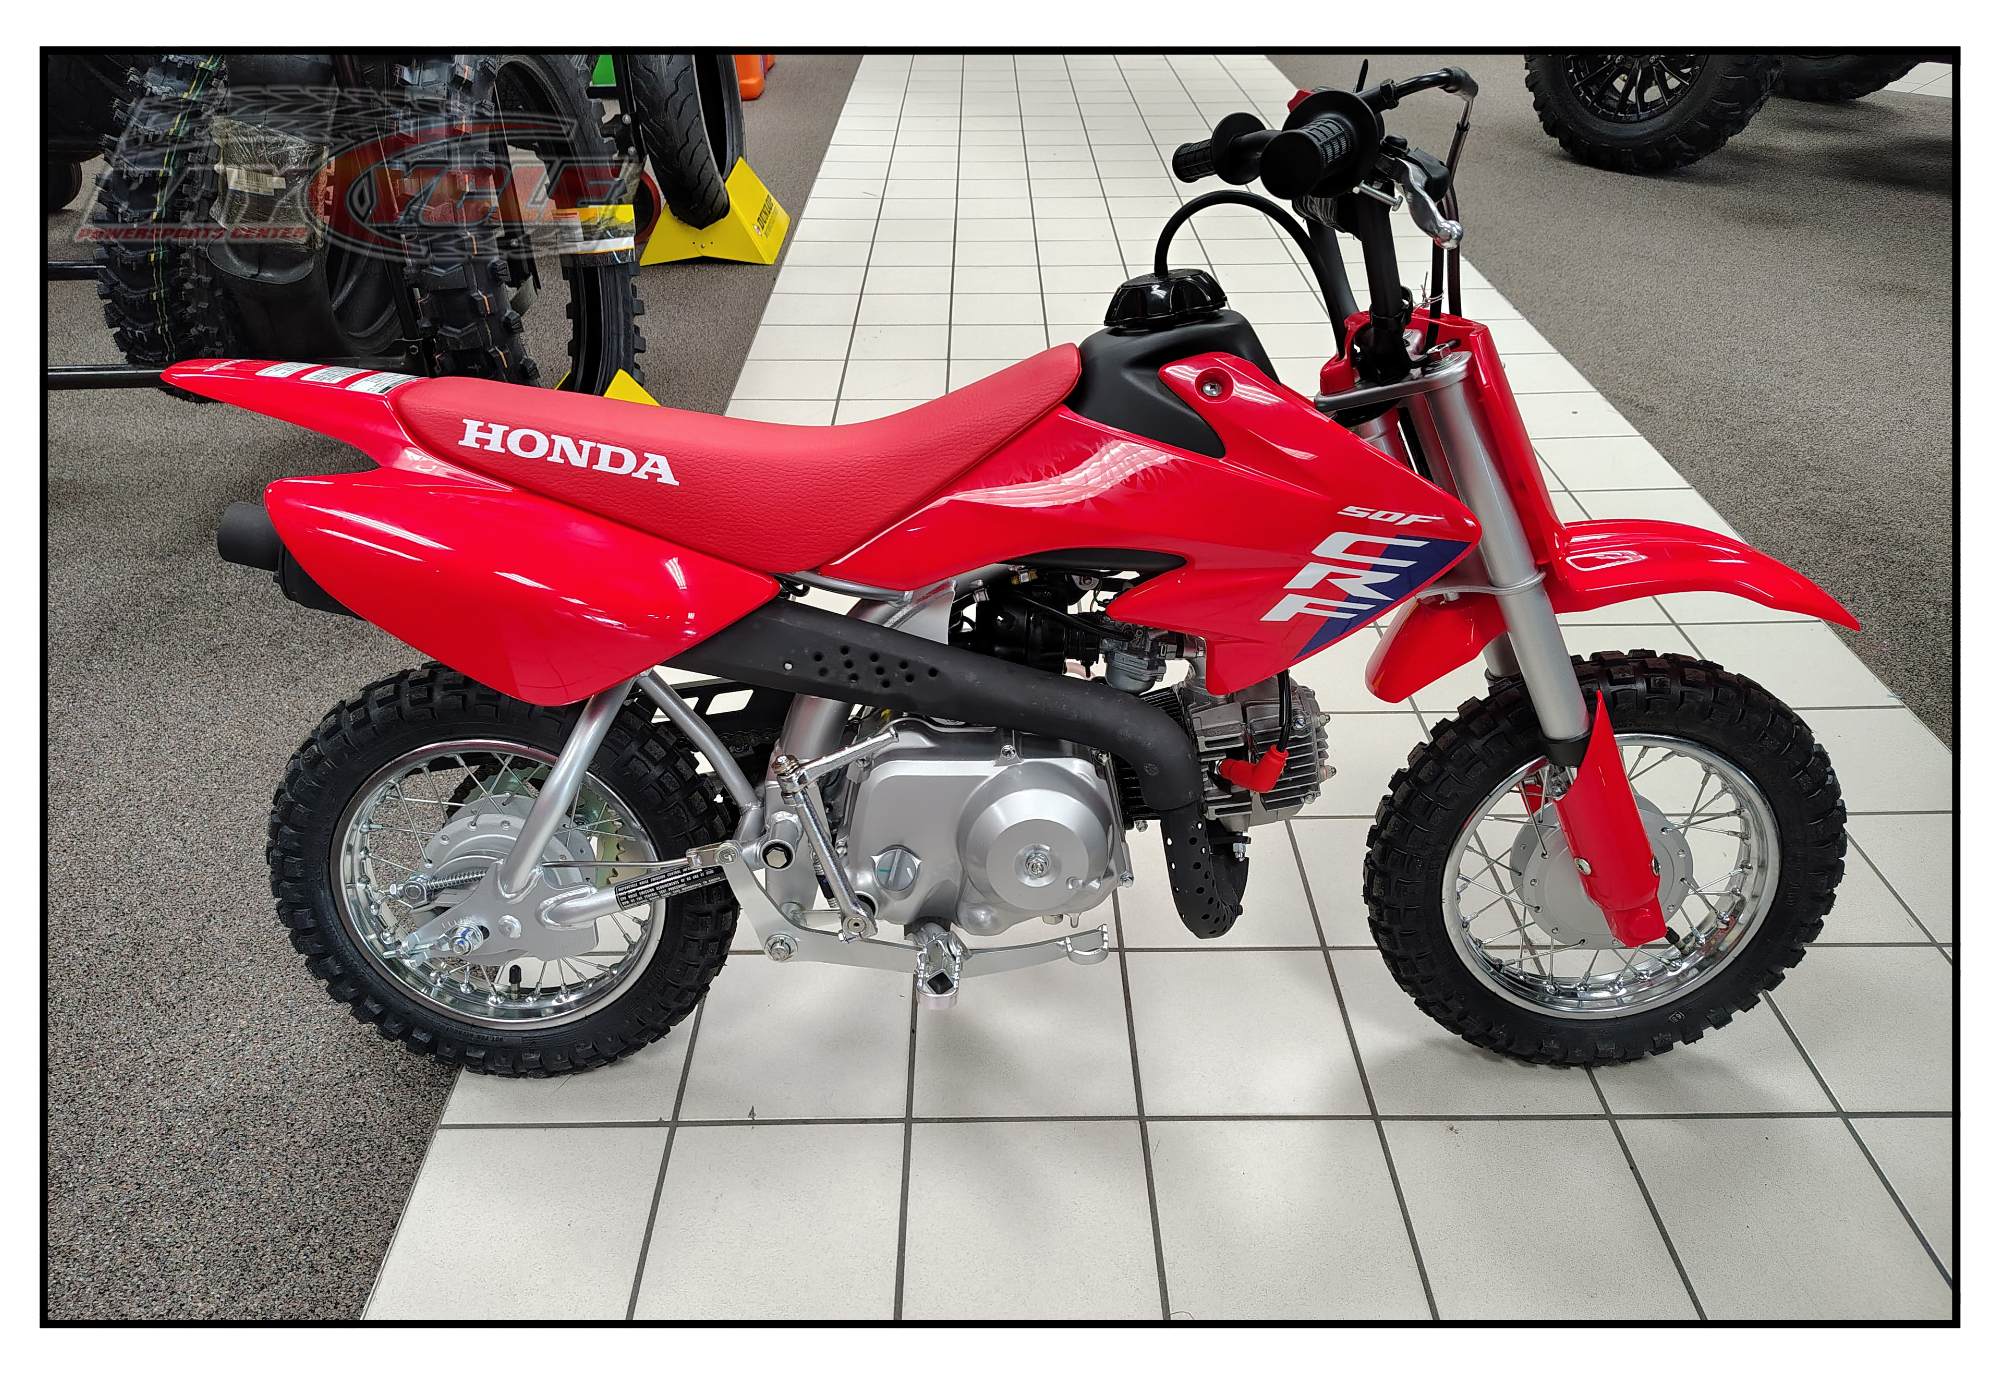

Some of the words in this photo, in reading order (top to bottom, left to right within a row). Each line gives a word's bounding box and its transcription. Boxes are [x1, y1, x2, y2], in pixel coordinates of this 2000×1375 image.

[757, 194, 773, 230] DUNLOP
[458, 418, 679, 486] HONDA
[1337, 506, 1445, 526] 50F
[1259, 531, 1430, 622] CRF
